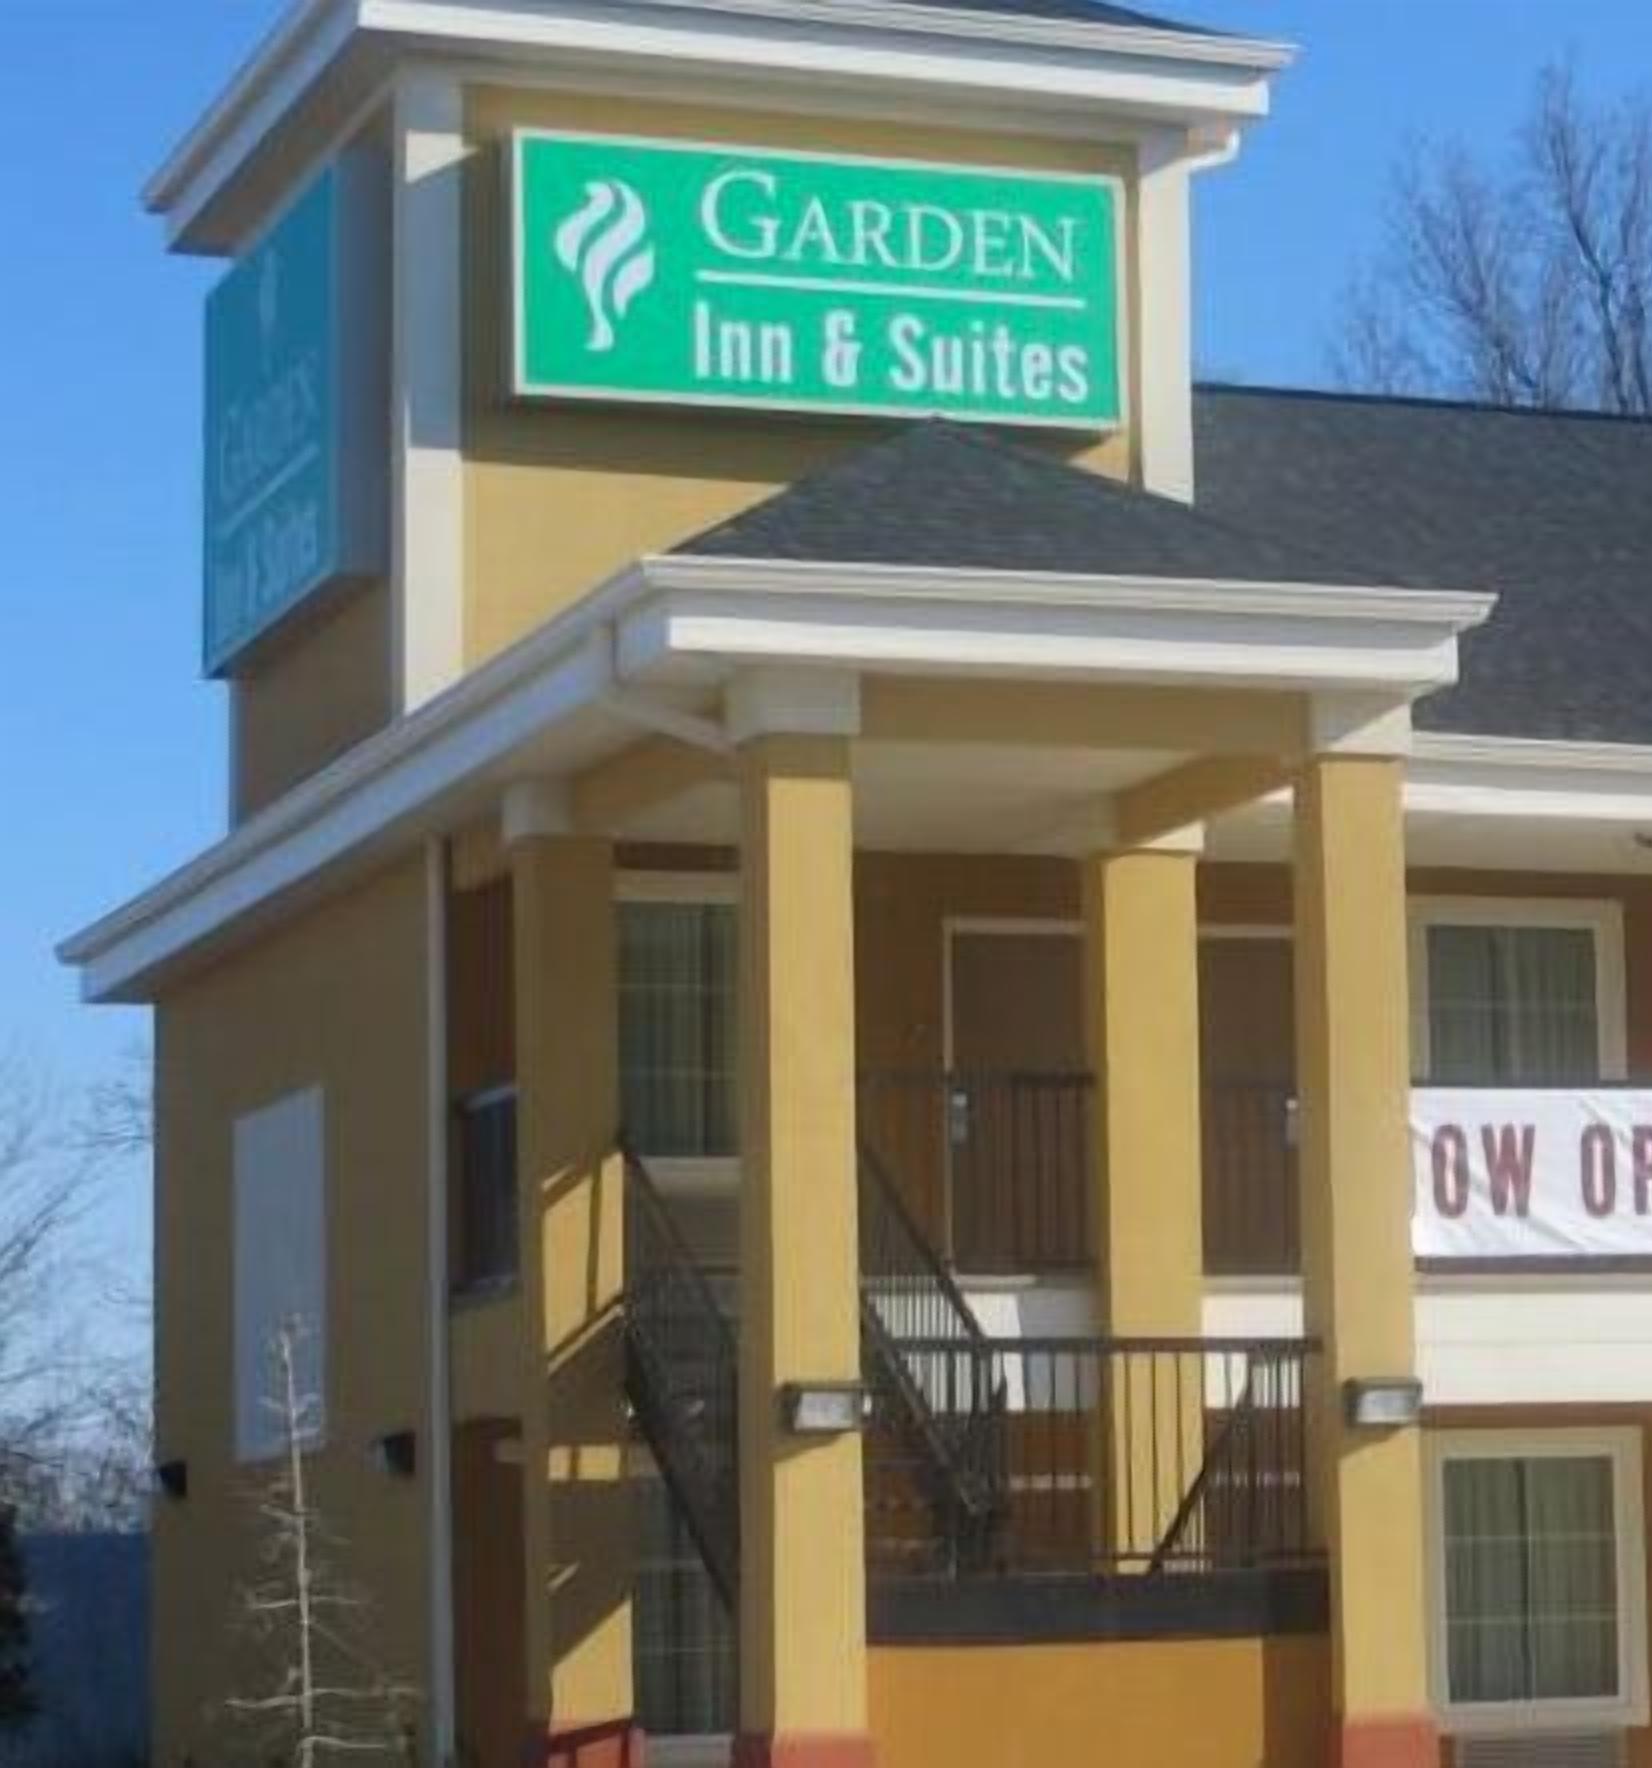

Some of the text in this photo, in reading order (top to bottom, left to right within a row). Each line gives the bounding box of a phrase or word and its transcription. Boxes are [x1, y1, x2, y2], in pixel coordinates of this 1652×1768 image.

[701, 169, 1078, 281] GARDEN
[693, 300, 1088, 402] Inn & Suites
[1431, 1123, 1536, 1219] OW
